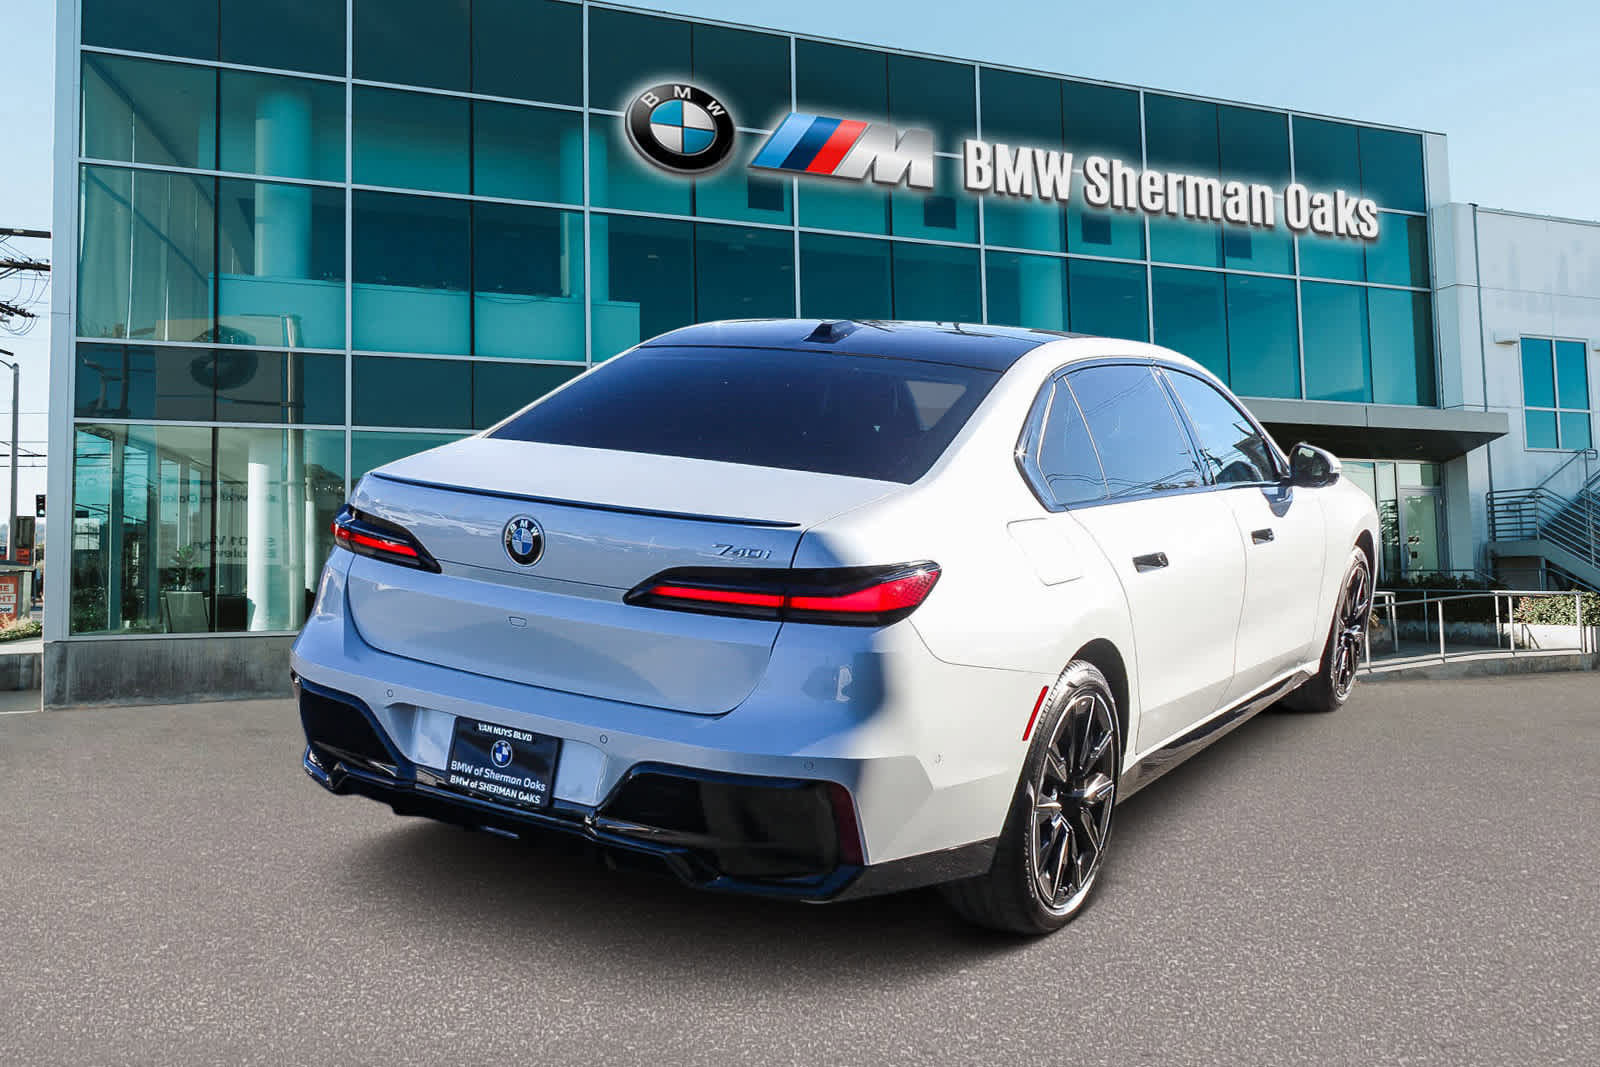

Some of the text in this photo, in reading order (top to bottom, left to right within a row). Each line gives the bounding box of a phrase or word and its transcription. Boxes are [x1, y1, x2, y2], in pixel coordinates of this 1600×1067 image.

[641, 84, 725, 117] BMW
[964, 139, 1379, 241] BMW Sherman Oaks
[509, 519, 540, 537] BMW
[711, 543, 773, 560] 740i
[478, 723, 533, 742] VAN NUYS BLVD
[450, 760, 546, 792] BMW of Sherman Oaks
[450, 774, 541, 804] BMW of SHERMAN OAKS
